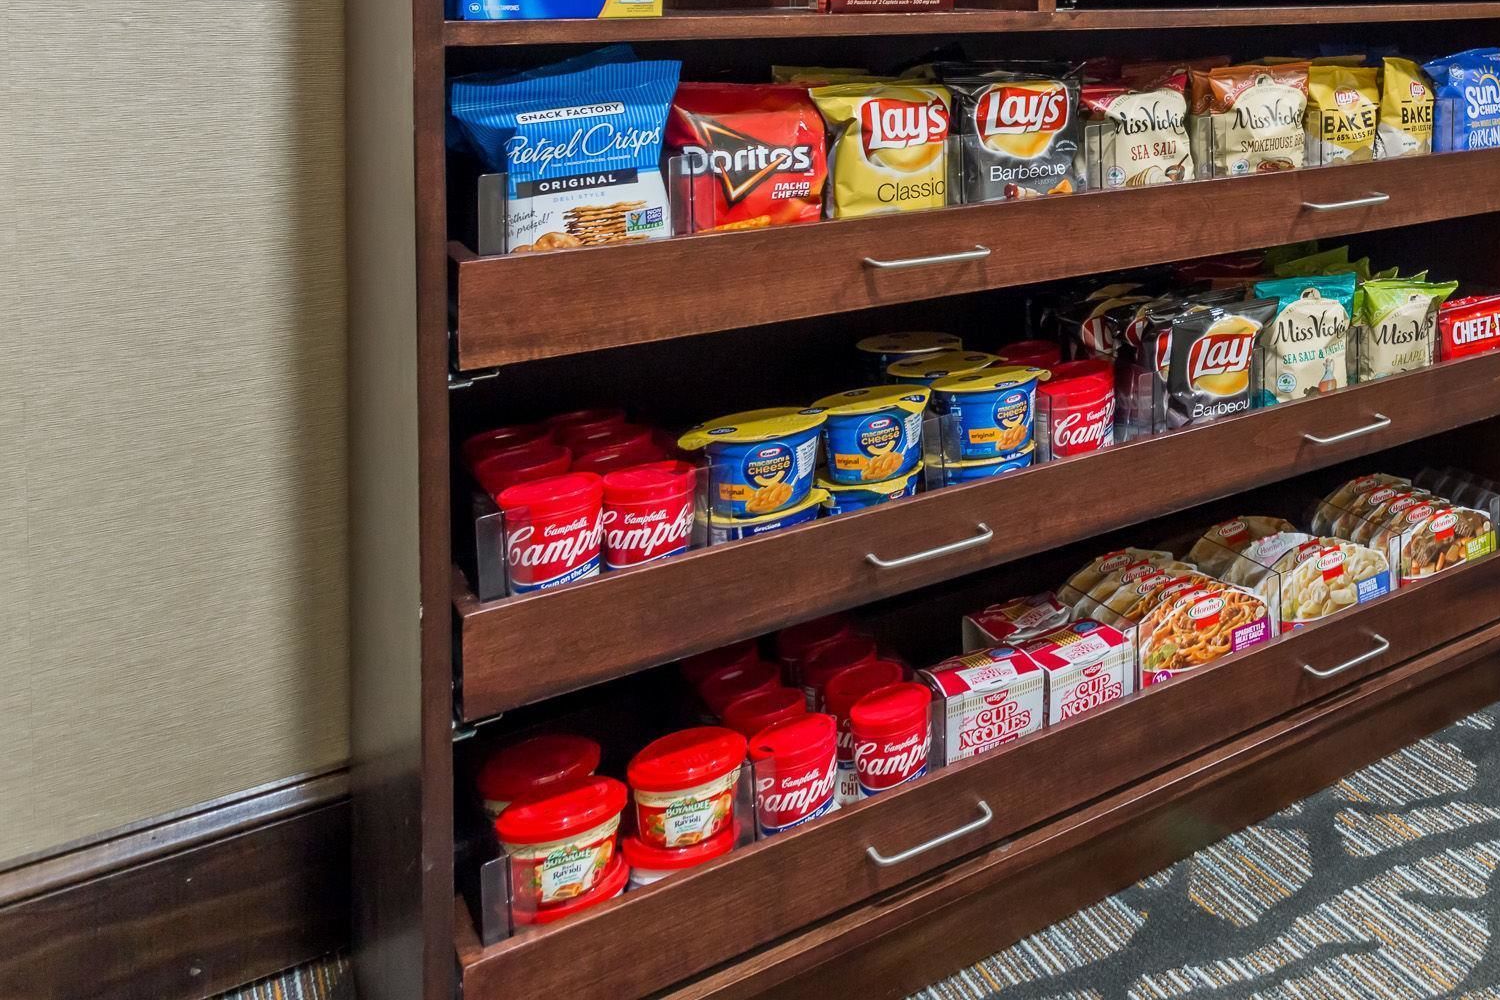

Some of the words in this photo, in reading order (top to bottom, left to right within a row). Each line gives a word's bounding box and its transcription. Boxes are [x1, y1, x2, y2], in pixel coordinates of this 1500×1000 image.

[520, 111, 562, 123] SNACK
[566, 104, 620, 117] FACTORY
[984, 89, 1065, 135] Lay's
[1231, 106, 1271, 130] Miss
[1401, 105, 1431, 125] BAKE
[869, 101, 948, 150] Lay's
[1324, 110, 1375, 134] BAKE
[1352, 131, 1367, 140] LESS
[505, 128, 582, 175] Pretzel
[582, 123, 661, 158] Crisps
[1131, 144, 1150, 161] SEA
[1153, 140, 1177, 157] SALT
[1240, 136, 1294, 153] SMOKEHOUSE
[681, 145, 809, 176] Doritos
[990, 163, 1066, 182] Barbecue
[539, 174, 617, 192] ORIGINAL
[775, 181, 810, 191] NACHO
[877, 177, 945, 203] Classic
[578, 191, 605, 199] STYLE
[771, 189, 810, 200] CHEESE
[627, 221, 664, 232] VERIFIED
[1274, 318, 1316, 345] Miss
[1377, 322, 1416, 346] Miss
[1282, 352, 1298, 365] SEA
[1299, 349, 1318, 362] SALT
[1318, 348, 1325, 359] &
[1391, 348, 1427, 367] JALAPE
[1192, 397, 1250, 418] Barbecu
[870, 418, 891, 428] Kraft
[860, 431, 901, 446] Cheese
[861, 427, 893, 440] macaroni
[970, 430, 996, 441] original
[760, 448, 780, 459] Kraft
[837, 456, 860, 466] original
[747, 460, 791, 476] Cheese
[748, 457, 785, 470] macaroni
[720, 486, 745, 498] original
[1371, 492, 1394, 504] Hormel
[1409, 509, 1432, 521] Hormel
[753, 521, 781, 533] directions
[1432, 517, 1456, 530] Hormel
[1319, 555, 1344, 567] Hormel
[1125, 567, 1152, 581] Hormel
[1193, 601, 1221, 615] Hormel
[1248, 629, 1263, 640] SAUCE
[1085, 665, 1104, 677] NISSIN
[1075, 673, 1111, 699] CUP
[986, 691, 1008, 703] NISSIN
[1060, 681, 1123, 721] NOODLES
[975, 701, 1018, 728] CUP
[959, 710, 1031, 750] NOODLES
[674, 815, 702, 828] Ravioli
[552, 865, 582, 880] Ravioli
